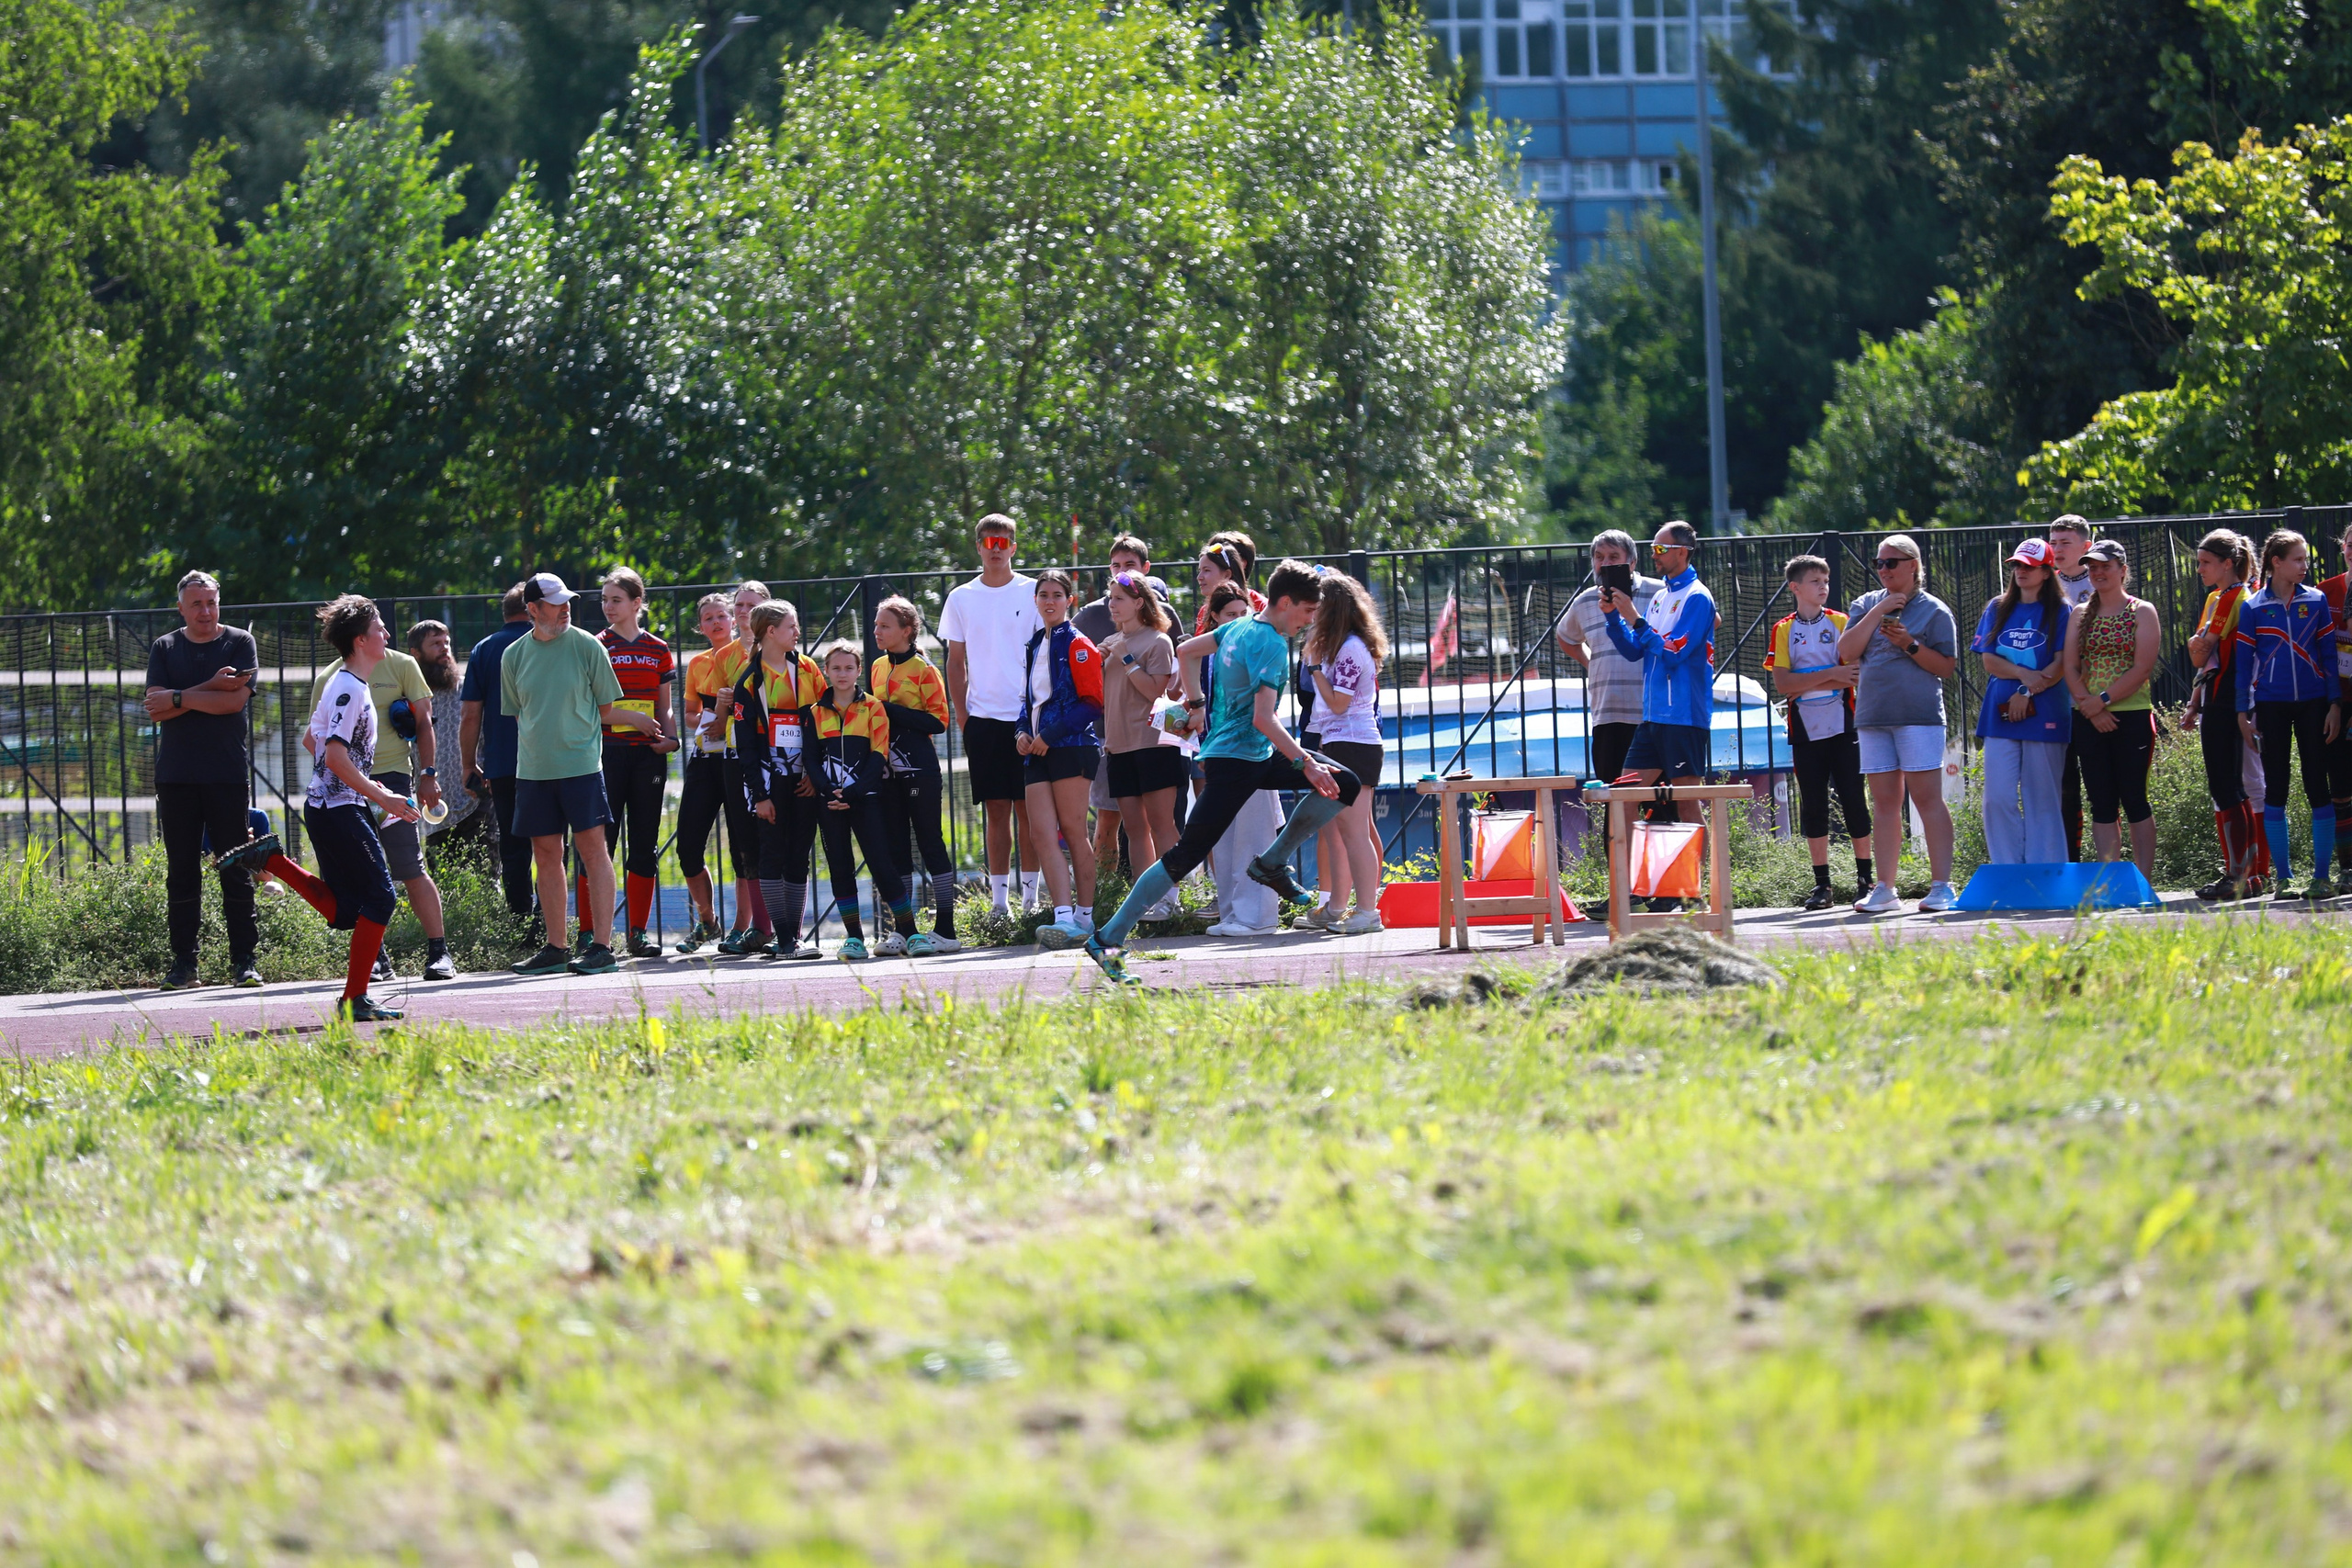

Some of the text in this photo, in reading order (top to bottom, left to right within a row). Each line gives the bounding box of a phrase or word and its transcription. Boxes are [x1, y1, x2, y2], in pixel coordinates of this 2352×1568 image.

[2008, 631, 2034, 640] SPORTY
[609, 655, 632, 665] ORD
[780, 729, 801, 738] 430.2
